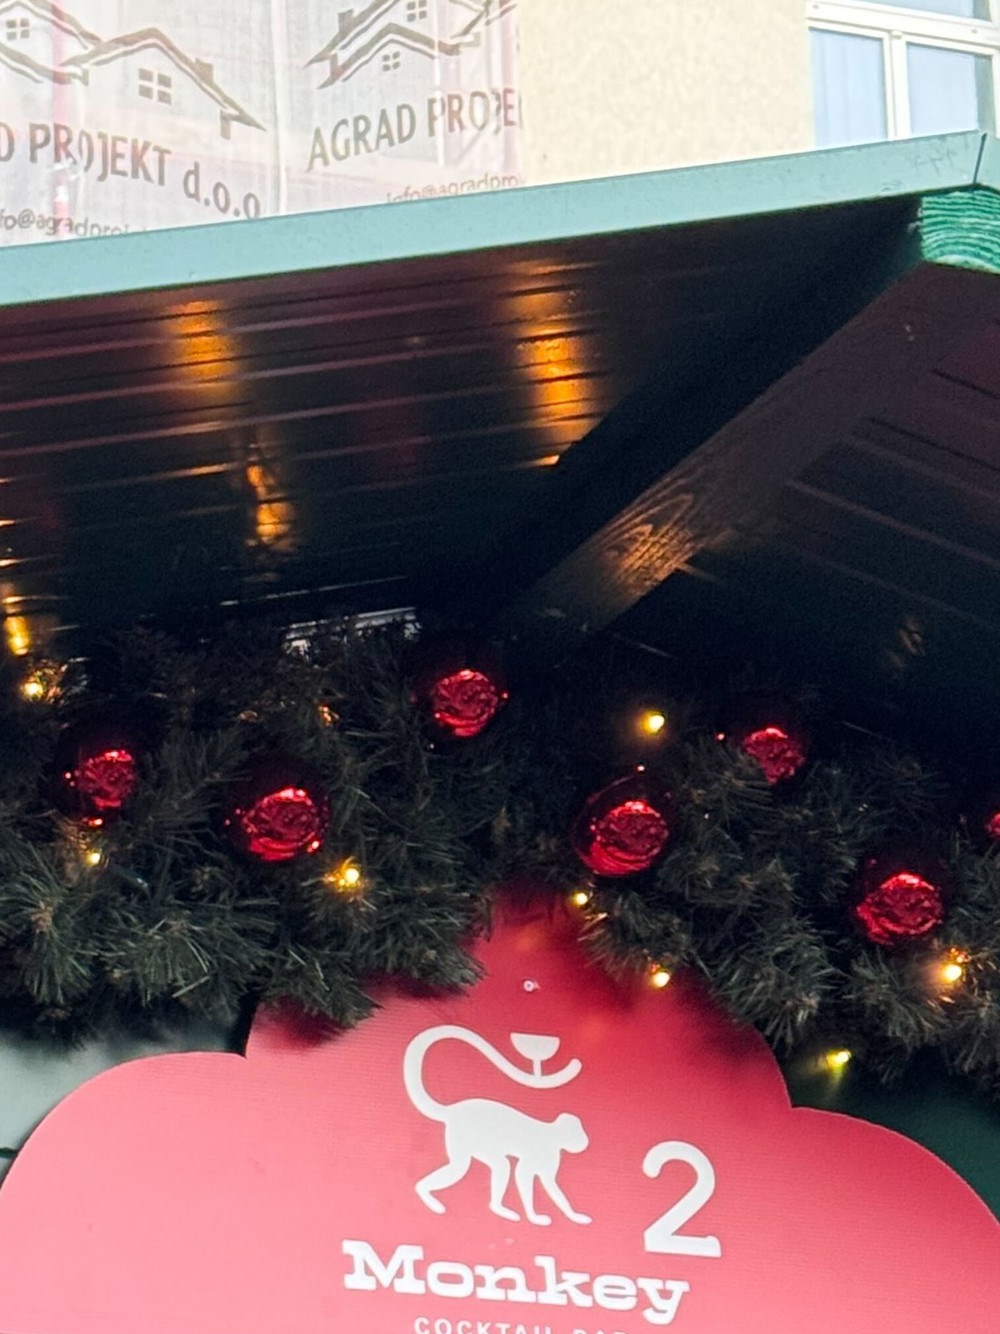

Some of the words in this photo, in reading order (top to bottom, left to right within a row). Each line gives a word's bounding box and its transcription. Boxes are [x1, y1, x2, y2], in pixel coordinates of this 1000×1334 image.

[28, 123, 173, 185] PROJEKT
[306, 103, 416, 173] AGRAD
[427, 87, 525, 137] PROJE
[642, 1140, 722, 1258] 2
[341, 1239, 690, 1325] Monkey
